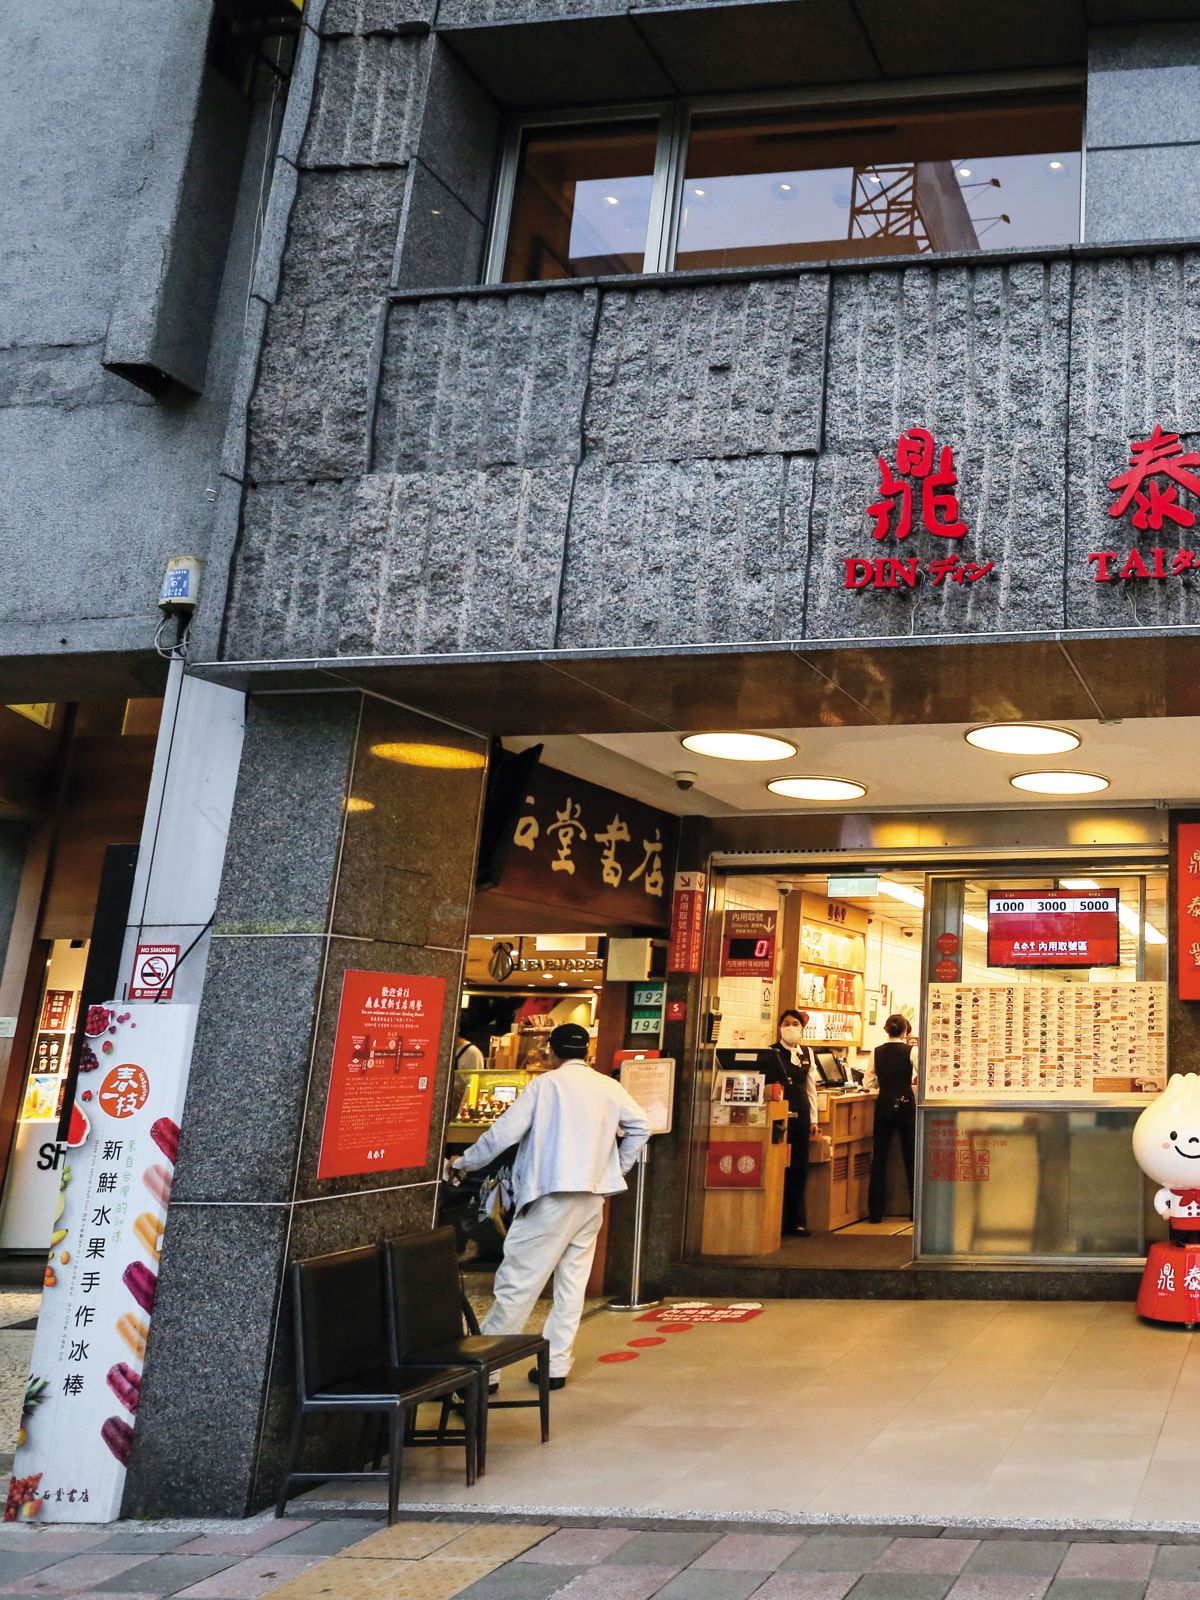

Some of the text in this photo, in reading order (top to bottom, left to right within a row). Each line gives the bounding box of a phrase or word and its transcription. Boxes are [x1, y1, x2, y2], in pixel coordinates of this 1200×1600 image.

[844, 557, 919, 589] DIN
[928, 553, 995, 587] ディン
[1087, 547, 1168, 583] TAI
[996, 901, 1109, 912] 1000 3000 5000
[754, 940, 768, 957] 0
[637, 992, 663, 1003] 192
[634, 1020, 660, 1031] 194
[101, 1066, 139, 1116] 春一枝
[63, 1140, 124, 1396] 新鮮水果手作冰棒
[29, 1487, 89, 1503] 石堂書店
